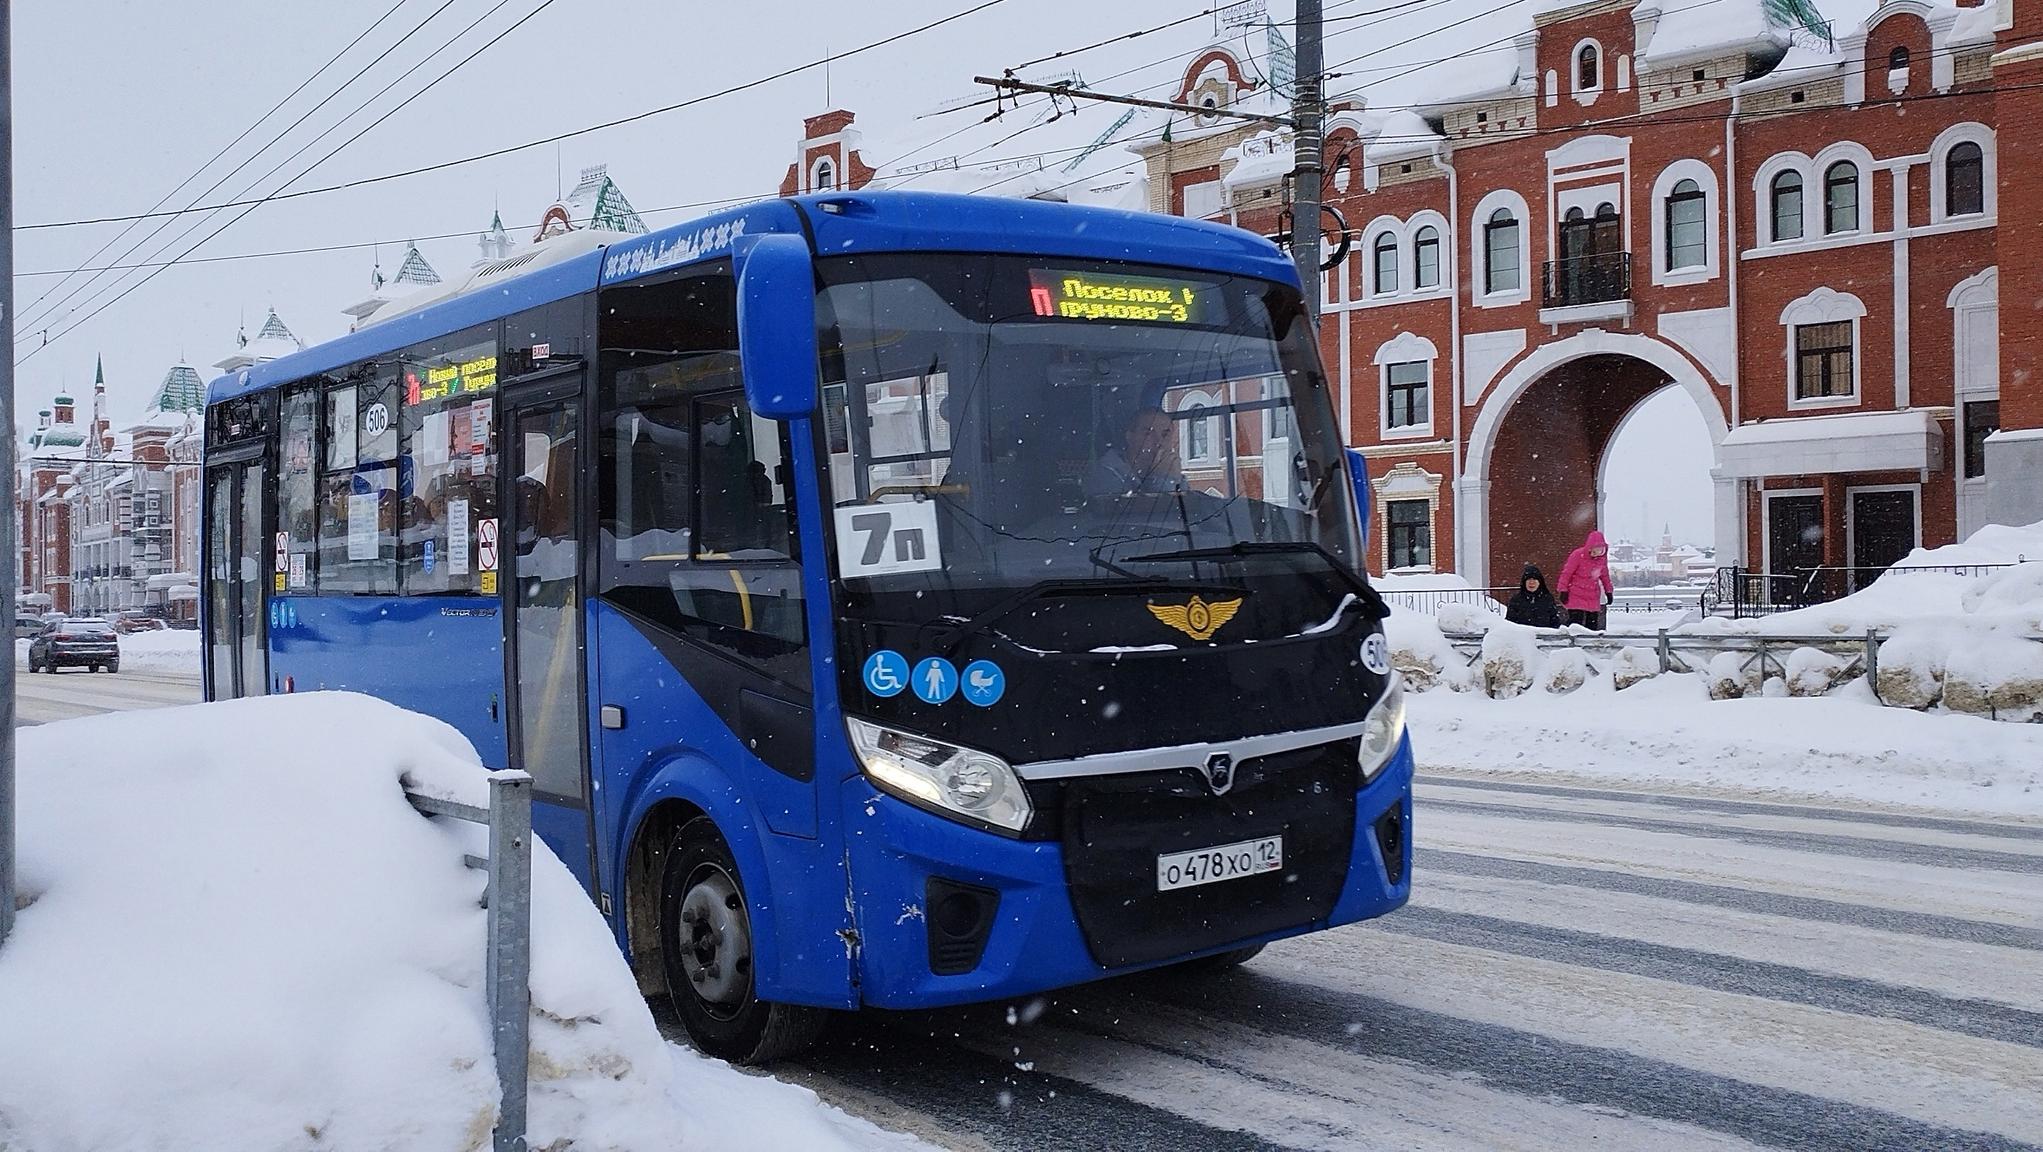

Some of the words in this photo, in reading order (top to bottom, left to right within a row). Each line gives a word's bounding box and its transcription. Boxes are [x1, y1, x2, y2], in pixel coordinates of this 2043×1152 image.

[1063, 279, 1173, 304] Поселок
[369, 408, 386, 432] 506
[852, 512, 926, 566] 7п
[1257, 841, 1276, 861] 12
